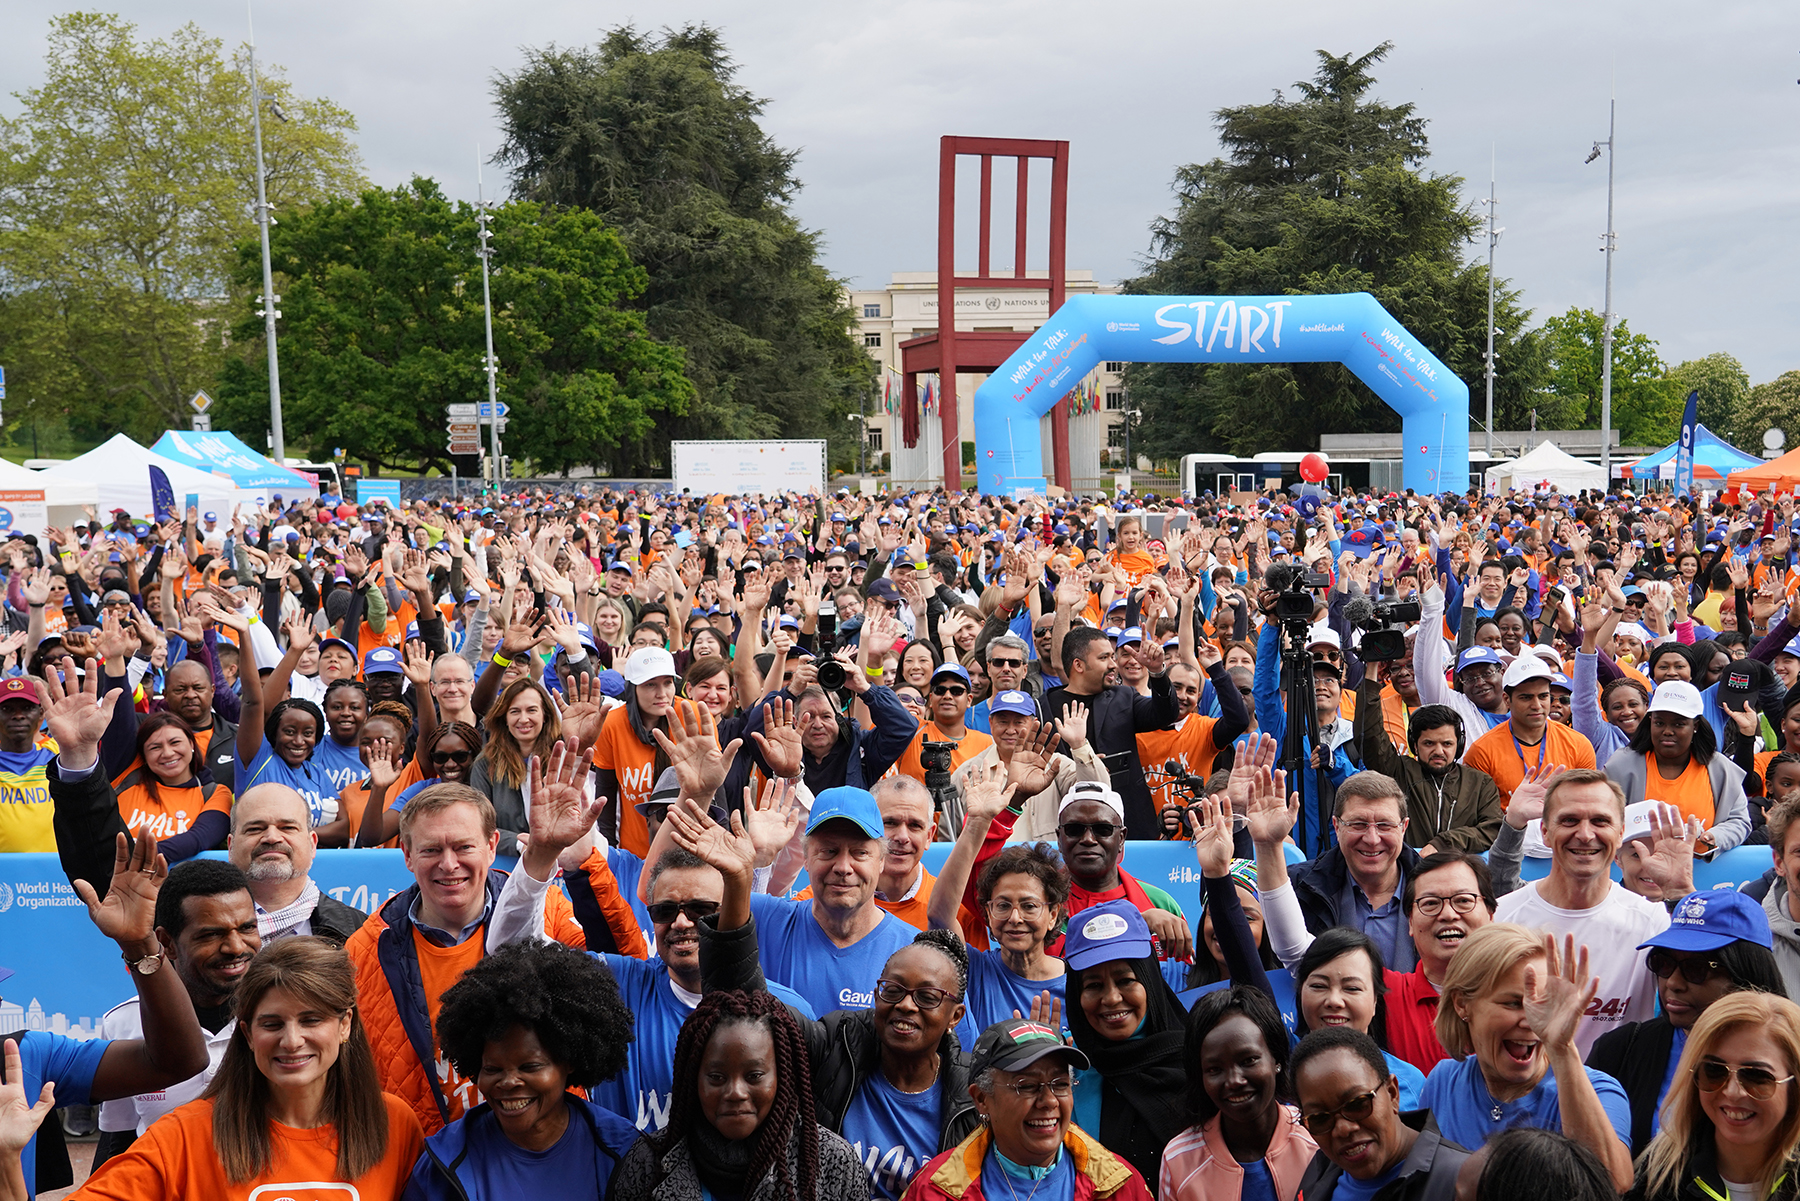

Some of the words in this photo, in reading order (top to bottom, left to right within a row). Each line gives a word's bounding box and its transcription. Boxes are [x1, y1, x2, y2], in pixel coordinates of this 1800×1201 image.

[1151, 300, 1292, 353] START
[1381, 328, 1406, 353] WALK
[1403, 348, 1416, 363] the
[1010, 358, 1037, 385] WALK
[1033, 349, 1048, 364] the
[622, 762, 654, 792] WA
[1, 786, 54, 805] WAND
[127, 808, 191, 838] WALK
[15, 883, 51, 894] World
[52, 883, 75, 894] Hea
[17, 894, 86, 909] Organizatio
[839, 988, 873, 1004] Gavi
